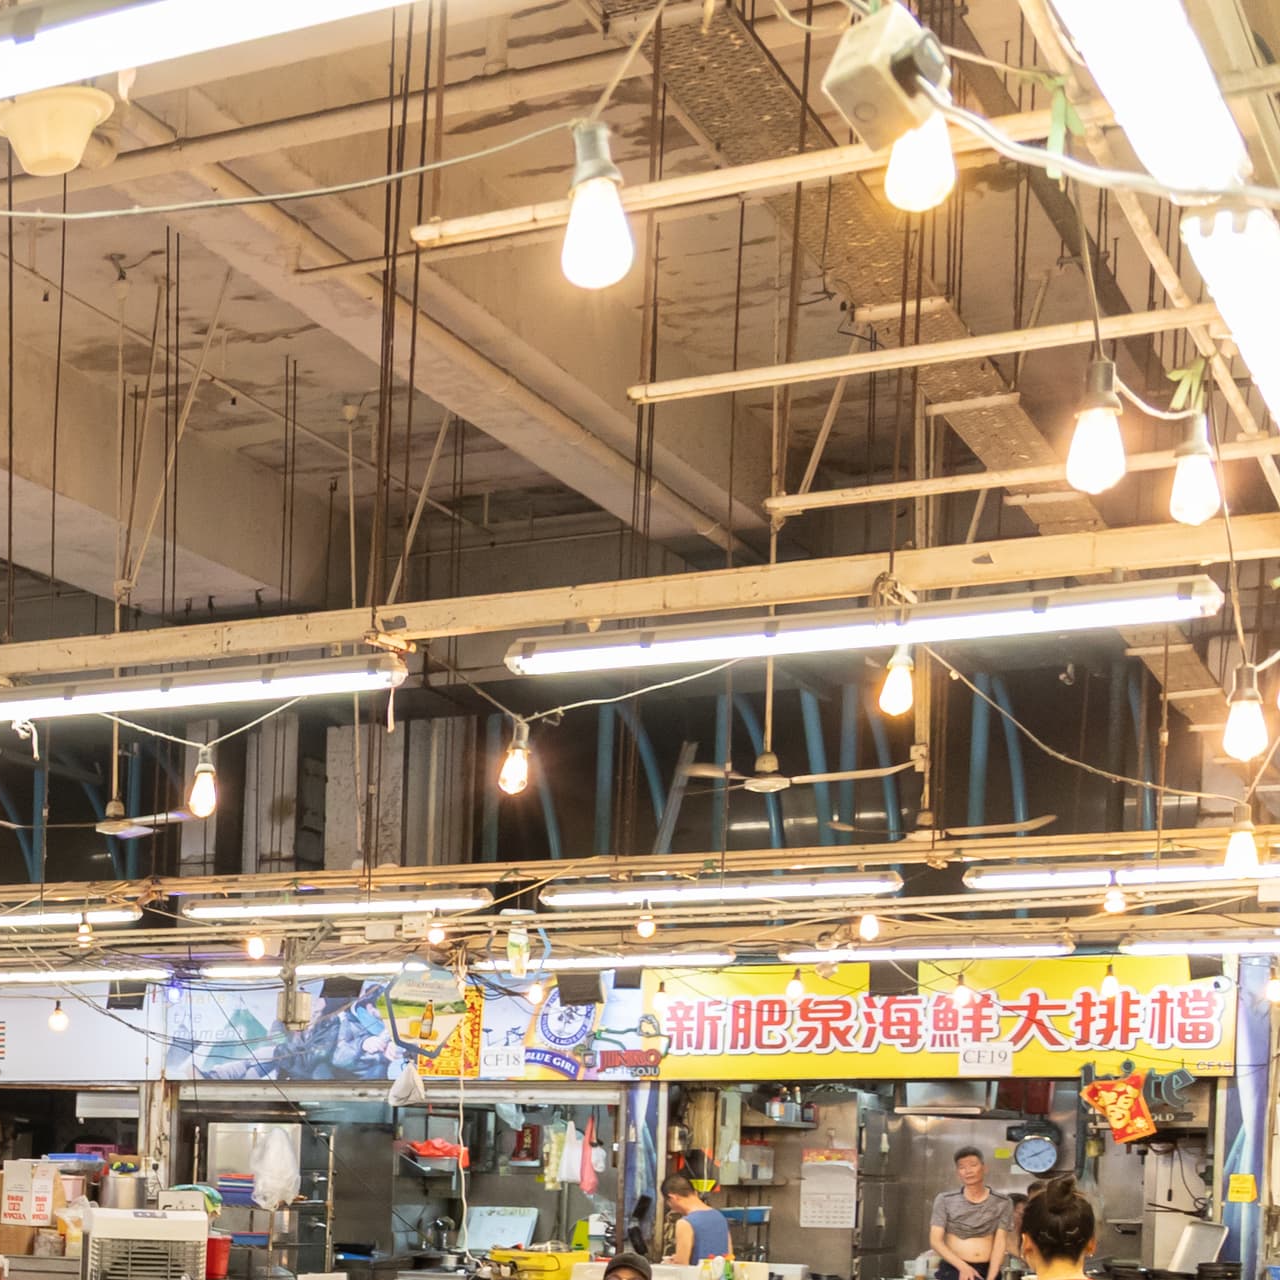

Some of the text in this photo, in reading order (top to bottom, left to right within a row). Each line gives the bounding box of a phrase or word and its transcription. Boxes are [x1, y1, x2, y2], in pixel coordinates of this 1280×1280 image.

[665, 989, 1218, 1050] 新肥泉海鮮大排檔
[483, 1055, 521, 1067] CF18
[526, 1052, 576, 1074] BLUE GIRL
[597, 1049, 663, 1073] JINRO
[962, 1051, 1008, 1065] CF19
[631, 1067, 660, 1077] SOJU
[1150, 1113, 1175, 1122] OLD
